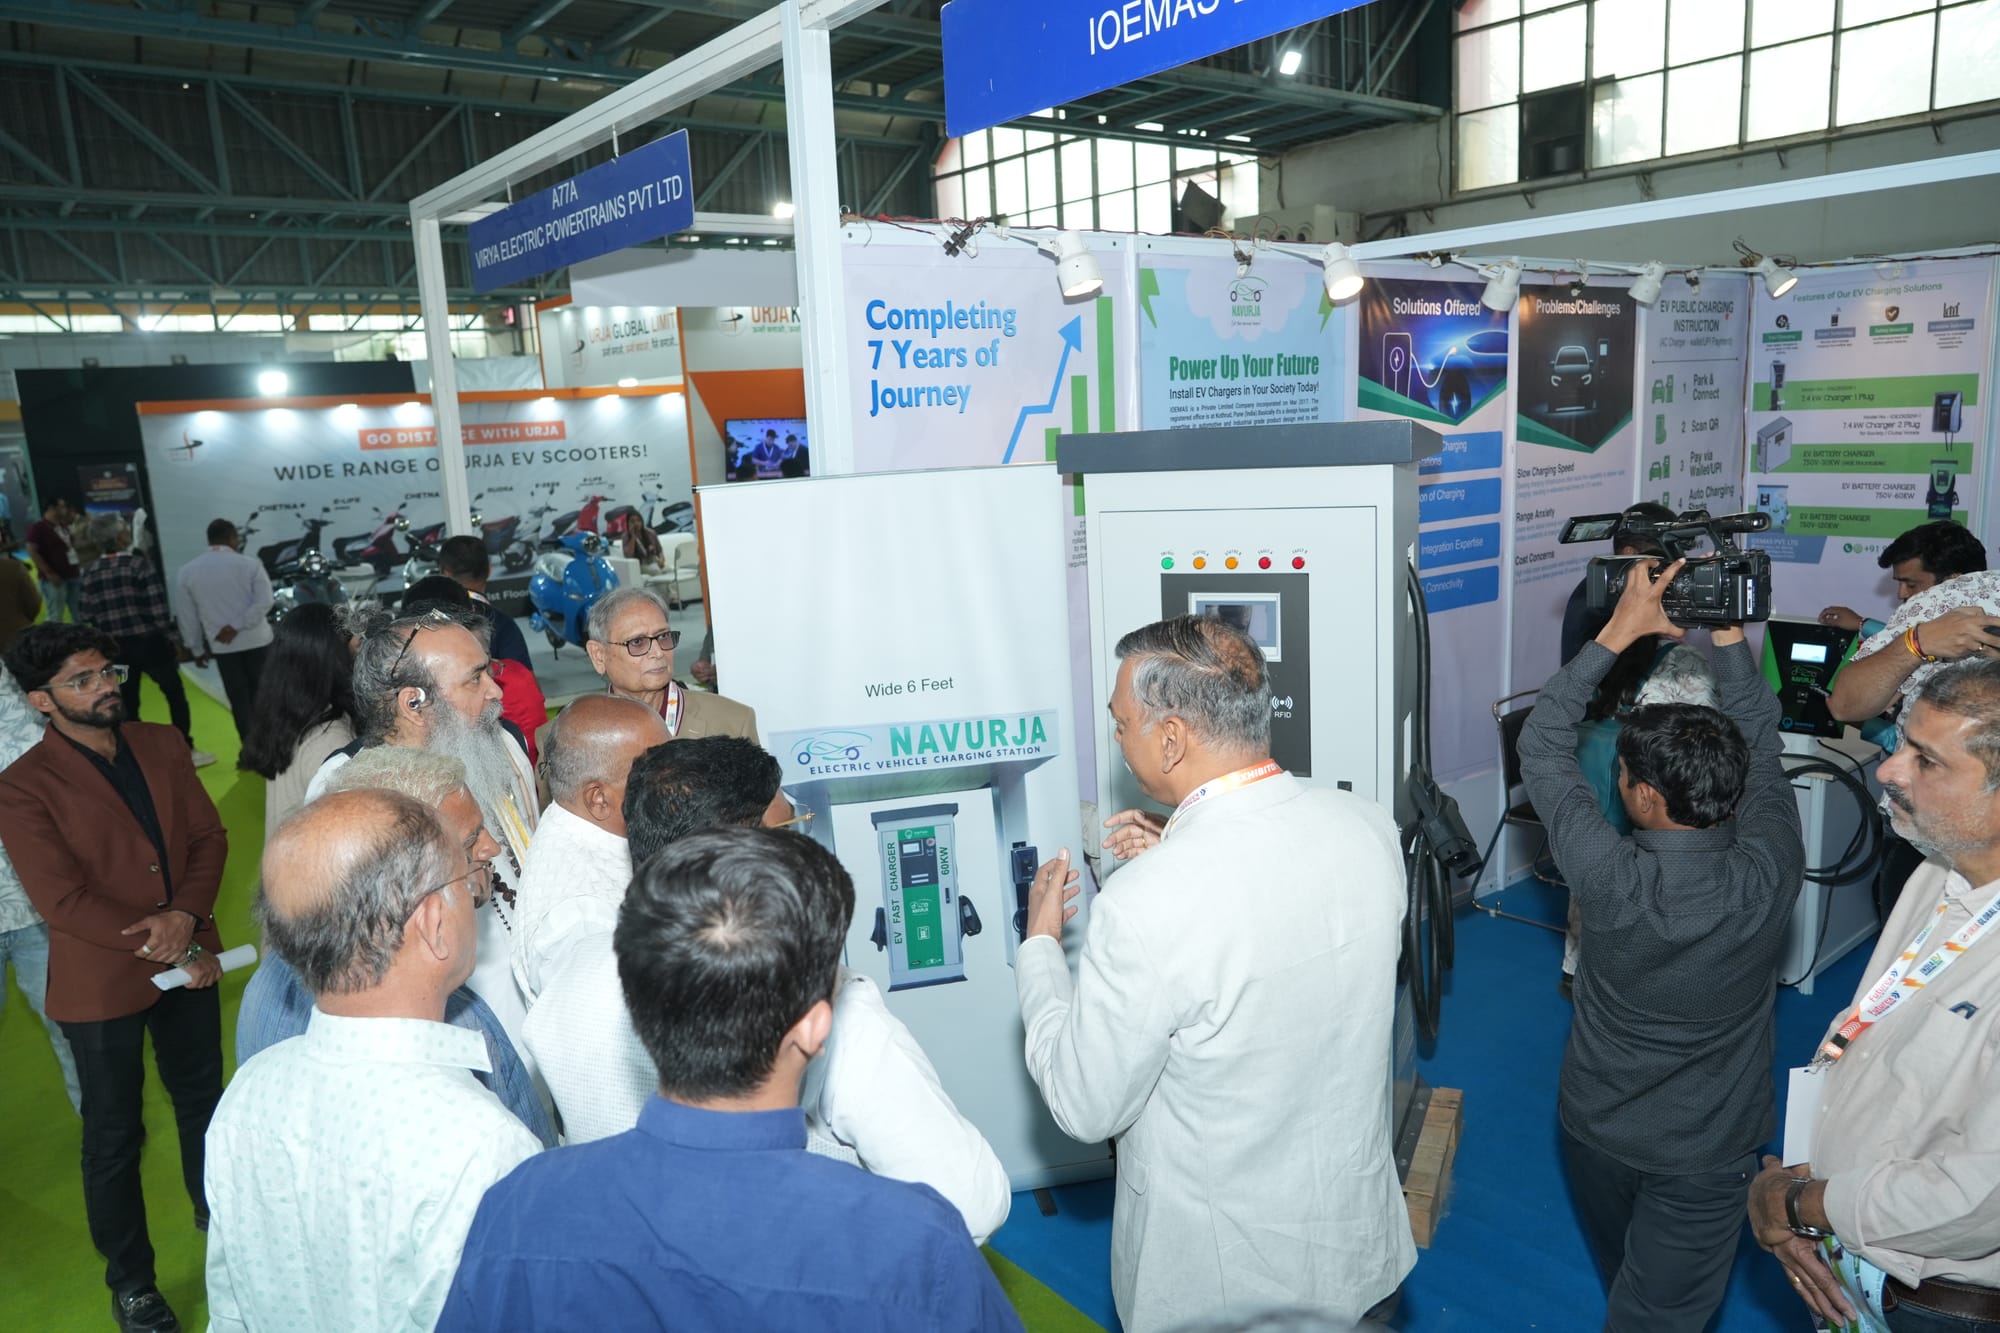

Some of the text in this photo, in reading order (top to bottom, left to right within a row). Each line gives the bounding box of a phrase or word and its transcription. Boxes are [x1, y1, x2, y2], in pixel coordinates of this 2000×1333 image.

[552, 181, 579, 209] A77A
[475, 175, 683, 269] VIRYA ELECTRIC POWERTRAINS PVT LTD
[1793, 293, 1826, 302] Features
[1837, 291, 1851, 299] Our
[1852, 289, 1864, 298] EV
[1865, 286, 1902, 297] Charging
[1903, 282, 1943, 293] Solutions
[1232, 305, 1261, 317] NAVURJA
[1393, 297, 1481, 316] Solutions Offered
[1536, 298, 1621, 318] Problems/Challenges
[1660, 300, 1735, 313] EV PUBLIC CHARGING
[866, 299, 1017, 338] Completing
[1674, 320, 1720, 332] INSTRUCTION
[613, 320, 650, 340] GLOBAL
[868, 338, 1000, 370] 7 Years of
[1170, 353, 1319, 381] Power Up Your Future
[1693, 374, 1708, 386] Park
[1709, 373, 1714, 384] &
[869, 379, 971, 417] Journey
[1169, 381, 1319, 400] Install EV Chargers in Your Society Today!
[1692, 389, 1720, 401] Connect
[1823, 393, 1852, 403] Charger
[1858, 393, 1875, 403] Plug
[1681, 418, 1719, 433] 2 Scan QR
[1865, 421, 1895, 431] Charger
[1903, 421, 1921, 430] Plug
[367, 426, 560, 445] GO DISTCE WITH URJA
[274, 464, 335, 480] WIDE
[343, 459, 418, 477] RANGE
[512, 452, 535, 466] EV
[542, 445, 648, 464] SCOOTERS!
[1680, 450, 1713, 472] 3 Pay via
[1812, 450, 1841, 458] BATTERY
[1843, 450, 1875, 458] CHARGER
[1517, 462, 1575, 479] Slow Charging Speed
[1690, 462, 1723, 477] Wallet/UPI
[1429, 488, 1465, 502] of Charging
[1842, 482, 1916, 491] EV BATTERY CHARGER
[1678, 485, 1735, 509] 4 Auto Charging
[1515, 508, 1555, 523] Range Anxiety
[1421, 536, 1484, 556] Integration Expertise
[1515, 551, 1555, 566] Cost Concerns
[1426, 578, 1464, 594] Connectivity
[865, 676, 955, 698] Wide 6 Feet
[1274, 711, 1292, 719] RFID
[890, 716, 1047, 756] NAVURJA
[810, 746, 1041, 775] ELECTRIC VEHICLE CHARGING STATION
[1239, 763, 1280, 780] EXHIBITO
[939, 847, 950, 876] 60KW
[888, 842, 903, 944] EV FAST CHARGER
